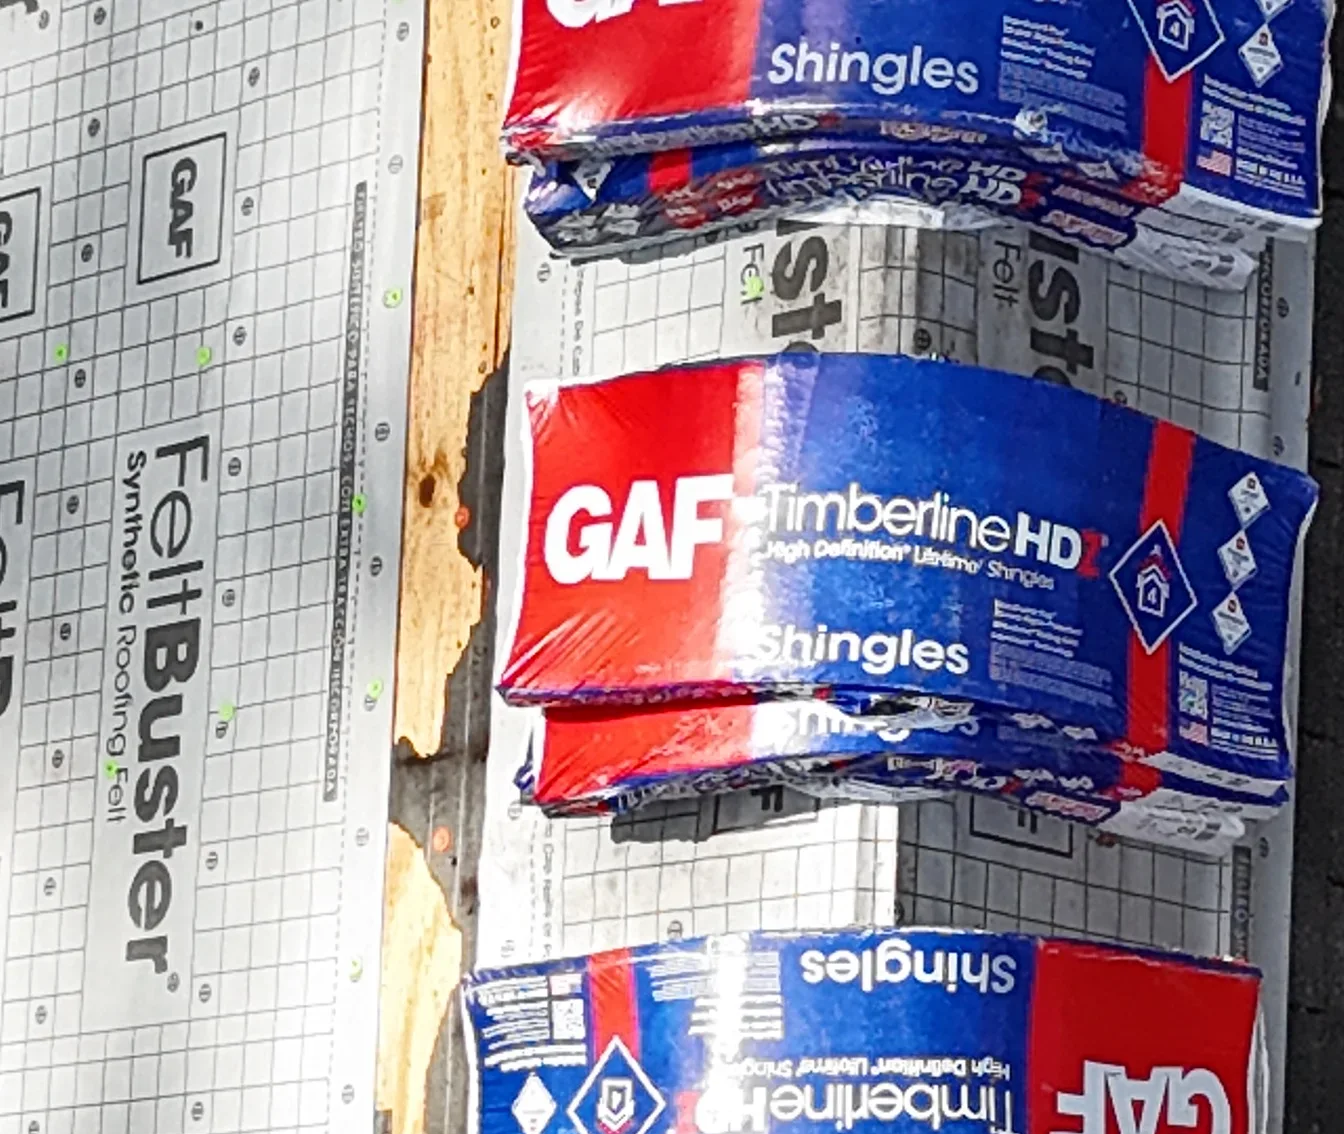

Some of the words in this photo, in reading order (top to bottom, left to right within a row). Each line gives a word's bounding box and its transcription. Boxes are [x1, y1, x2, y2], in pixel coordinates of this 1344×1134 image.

[766, 43, 981, 96] Shingles
[167, 156, 199, 260] GAF
[993, 240, 1021, 308] Felt
[116, 450, 147, 615] Synthetic
[544, 474, 733, 584] GAF
[756, 624, 970, 675] Shingles
[106, 624, 137, 758] Roofing
[106, 767, 128, 825] Felt
[800, 937, 1018, 993] Shingles
[971, 1056, 1011, 1081] High
